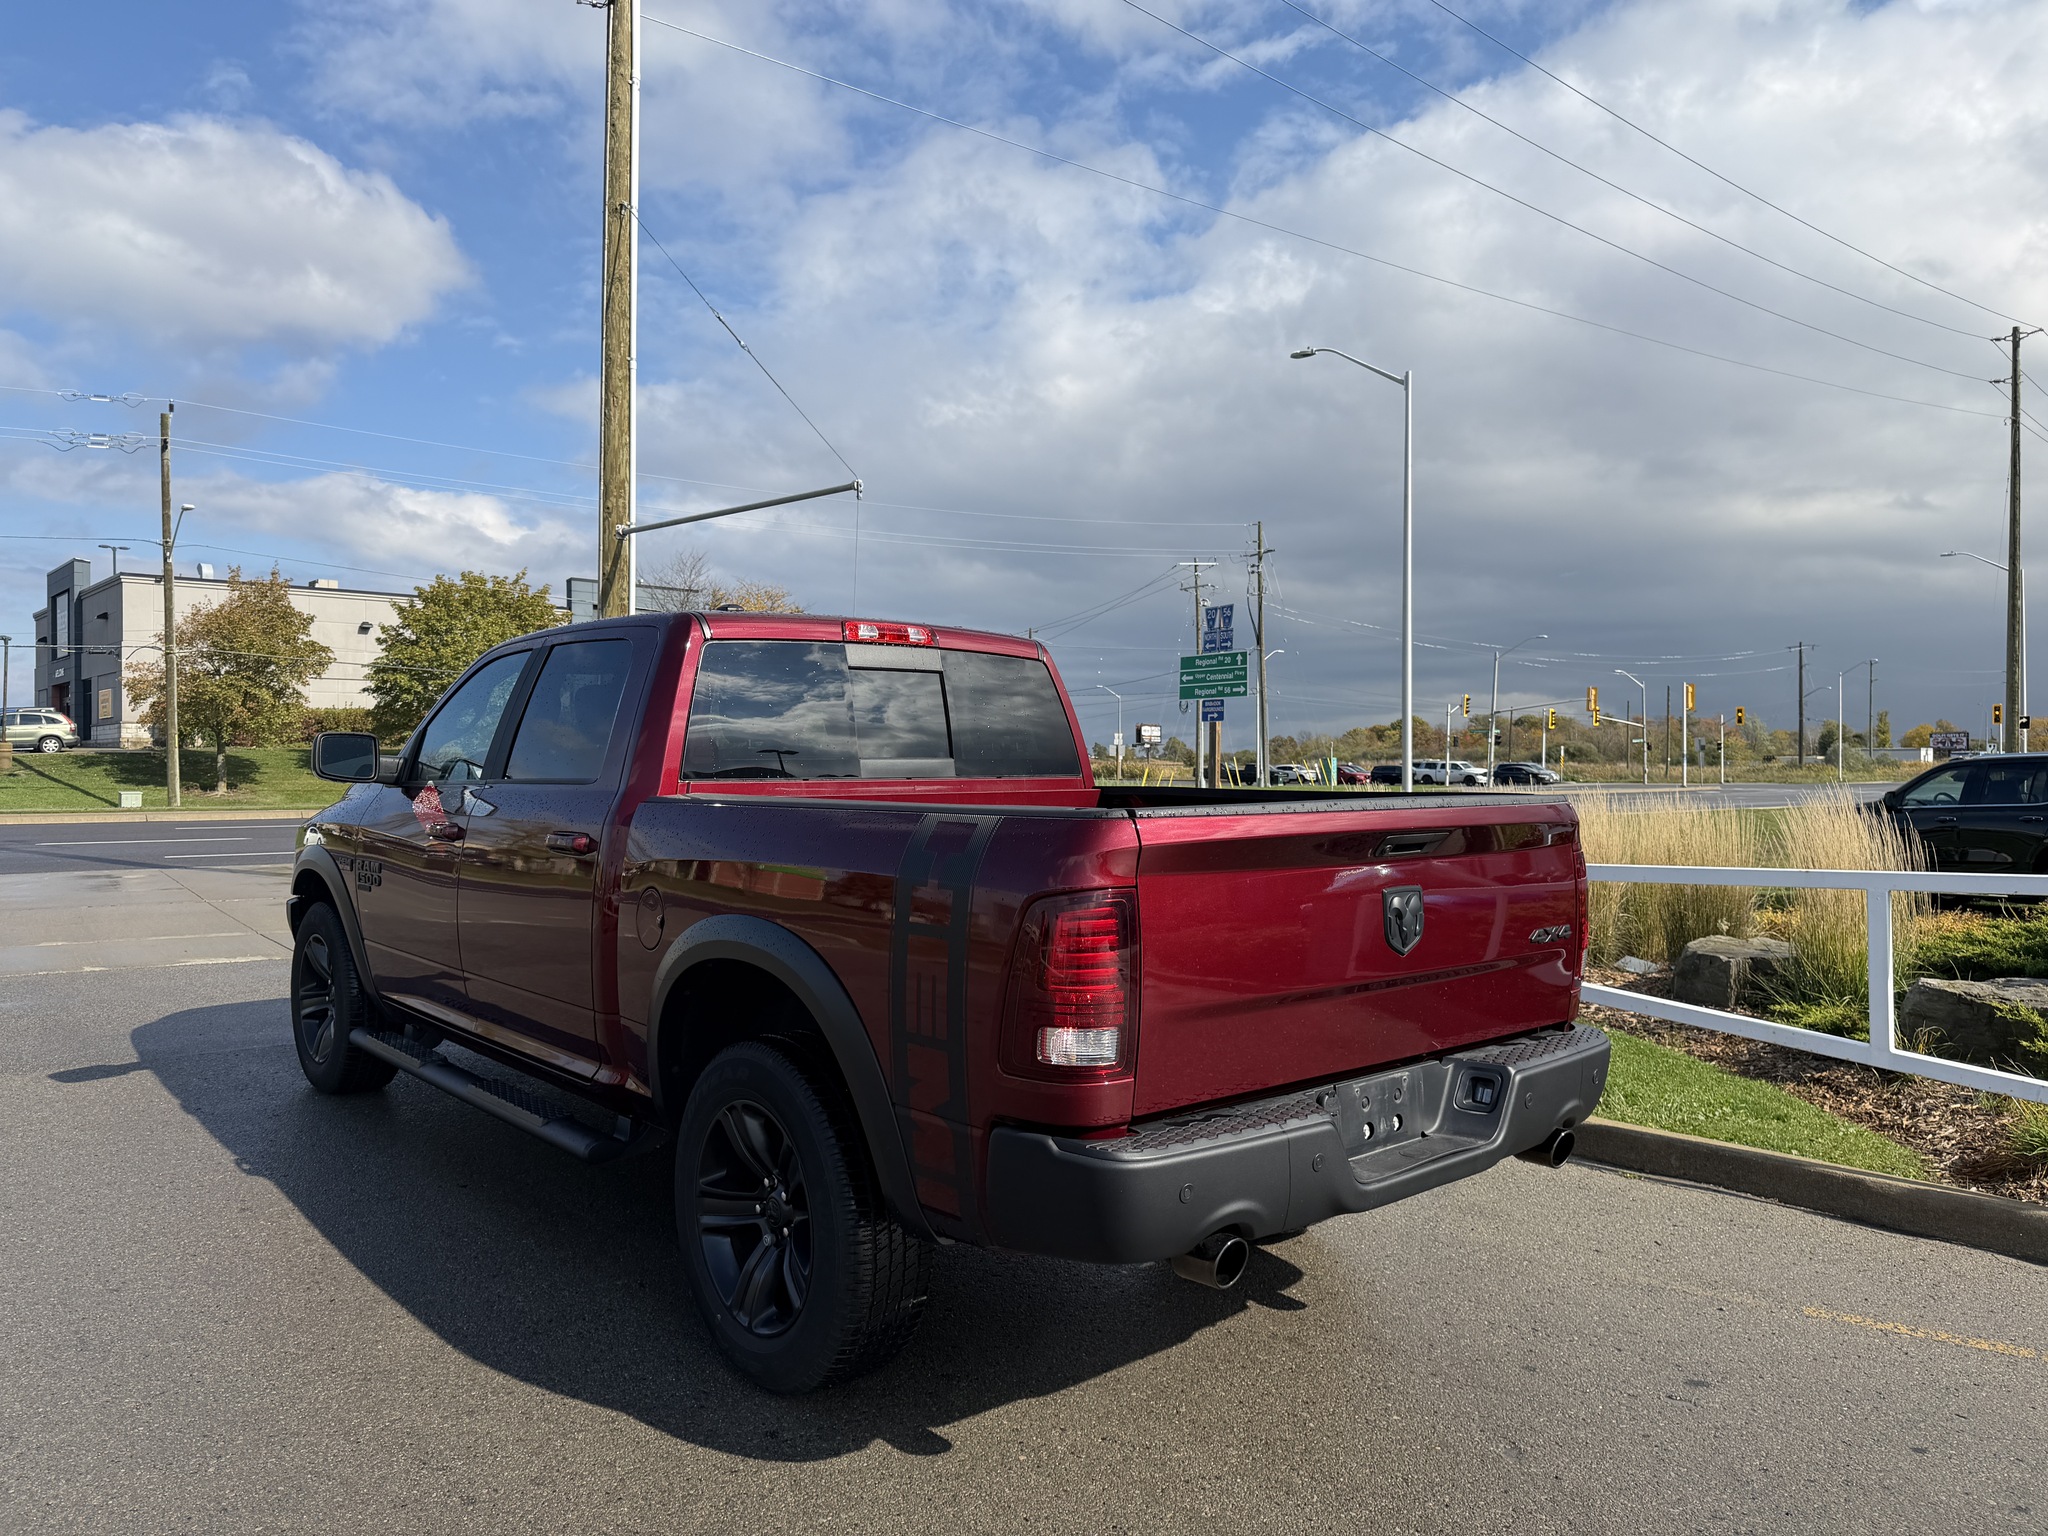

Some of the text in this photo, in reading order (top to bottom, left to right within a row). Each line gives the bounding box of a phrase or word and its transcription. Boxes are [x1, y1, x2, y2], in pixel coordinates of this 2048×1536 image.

[1207, 609, 1216, 619] 20
[1223, 607, 1232, 617] 56
[1220, 630, 1233, 640] SOUTH
[1195, 657, 1218, 667] Regional
[1224, 656, 1231, 664] 20
[1206, 672, 1234, 681] Centennial
[1194, 687, 1217, 697] Regional
[1224, 686, 1231, 694] 56
[356, 860, 382, 874] RAM
